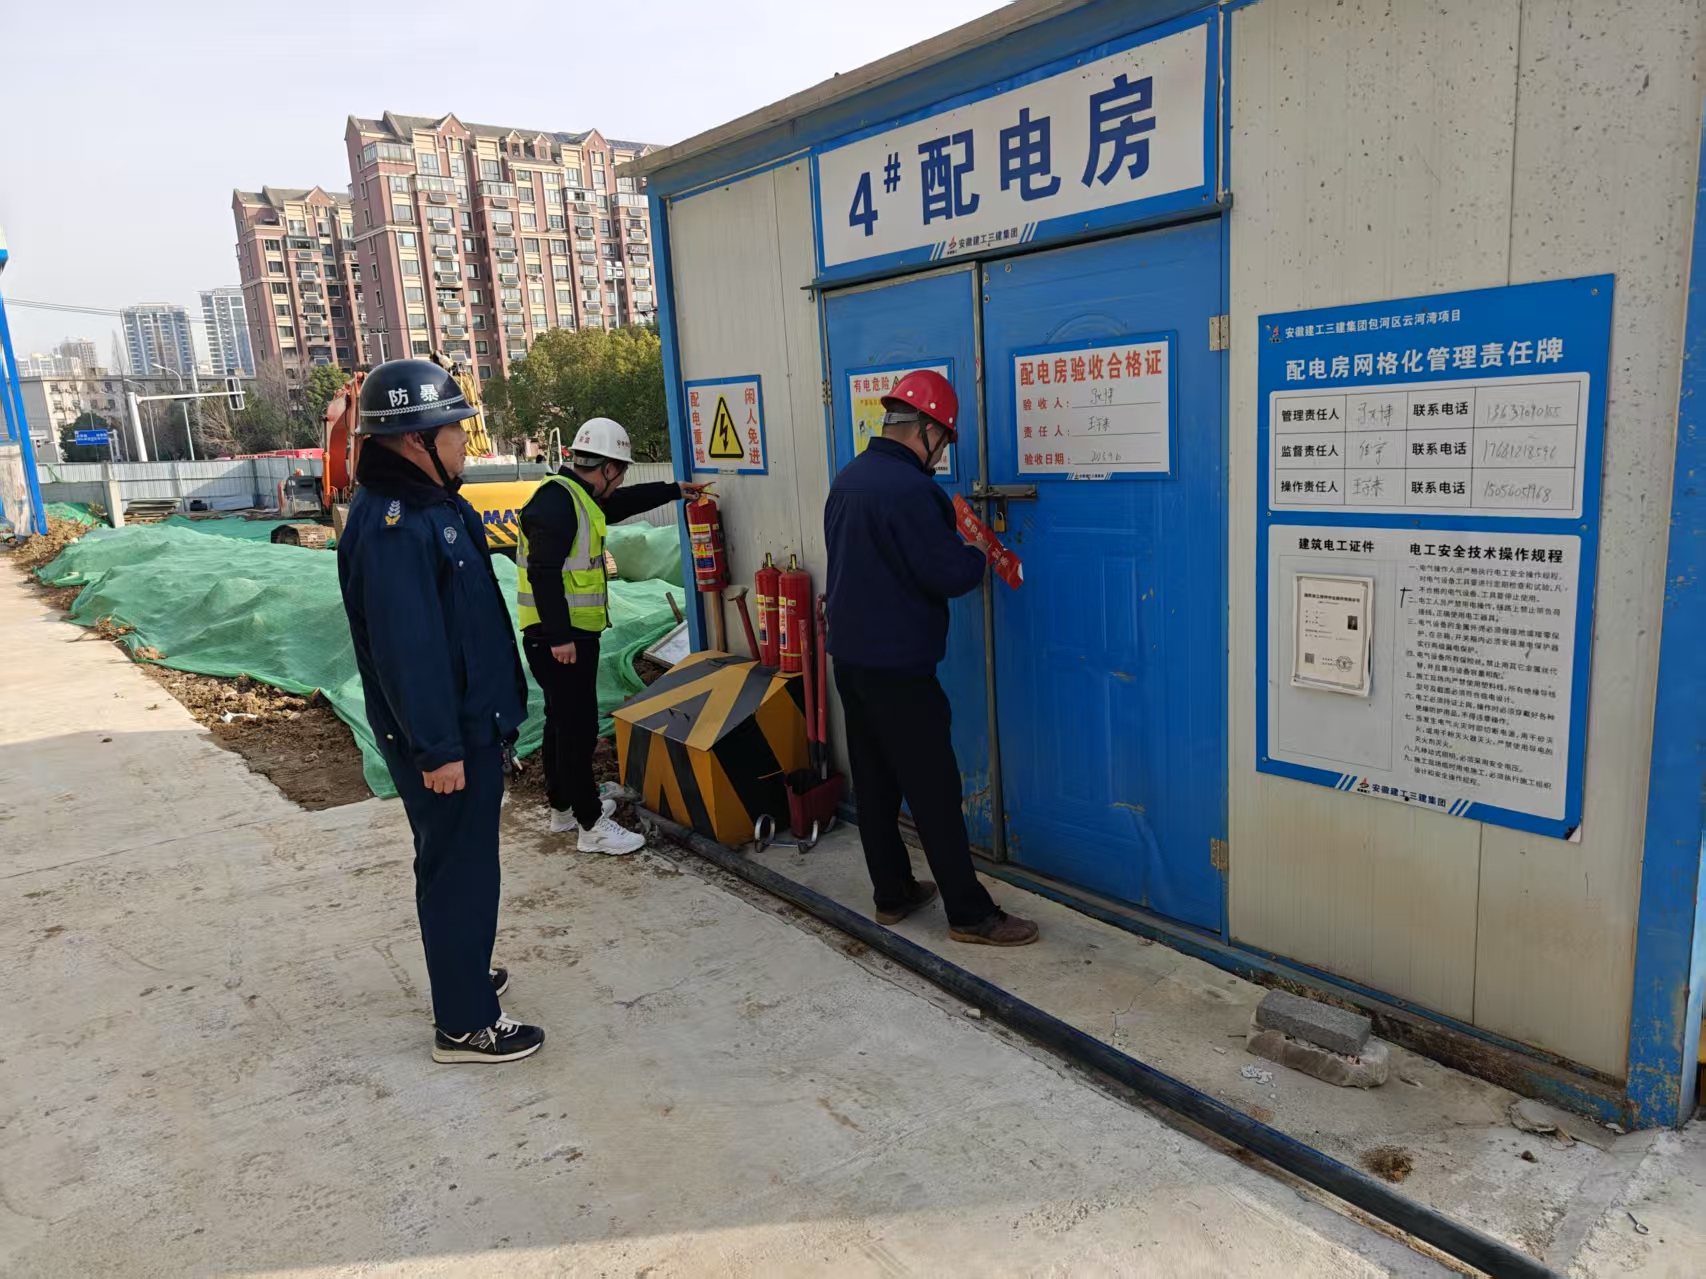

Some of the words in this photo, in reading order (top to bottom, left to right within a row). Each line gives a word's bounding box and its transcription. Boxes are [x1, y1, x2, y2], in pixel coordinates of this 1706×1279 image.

[958, 227, 1019, 250] 安徽建工三建集团
[1285, 309, 1461, 339] 安徽建工三建集团包河区云河湾项目
[1020, 349, 1162, 386] 配电房验收合格证
[1285, 337, 1564, 381] 配电房网格化管理责任牌
[388, 384, 439, 407] 防暴
[1281, 408, 1340, 423] 管理责任人
[1413, 402, 1469, 417] 联系电话
[690, 391, 705, 464] 配电重地
[744, 388, 761, 465] 闲人免进
[1280, 444, 1340, 458] 监督责任人
[1412, 442, 1468, 456] 联系电话
[1280, 480, 1339, 494] 操作责任人
[1411, 480, 1466, 495] 联系电话
[1298, 538, 1375, 553] 建筑电工证件
[1410, 543, 1564, 563] 电工安全技术操作规程
[1372, 783, 1447, 808] 安徽建工三建集团
